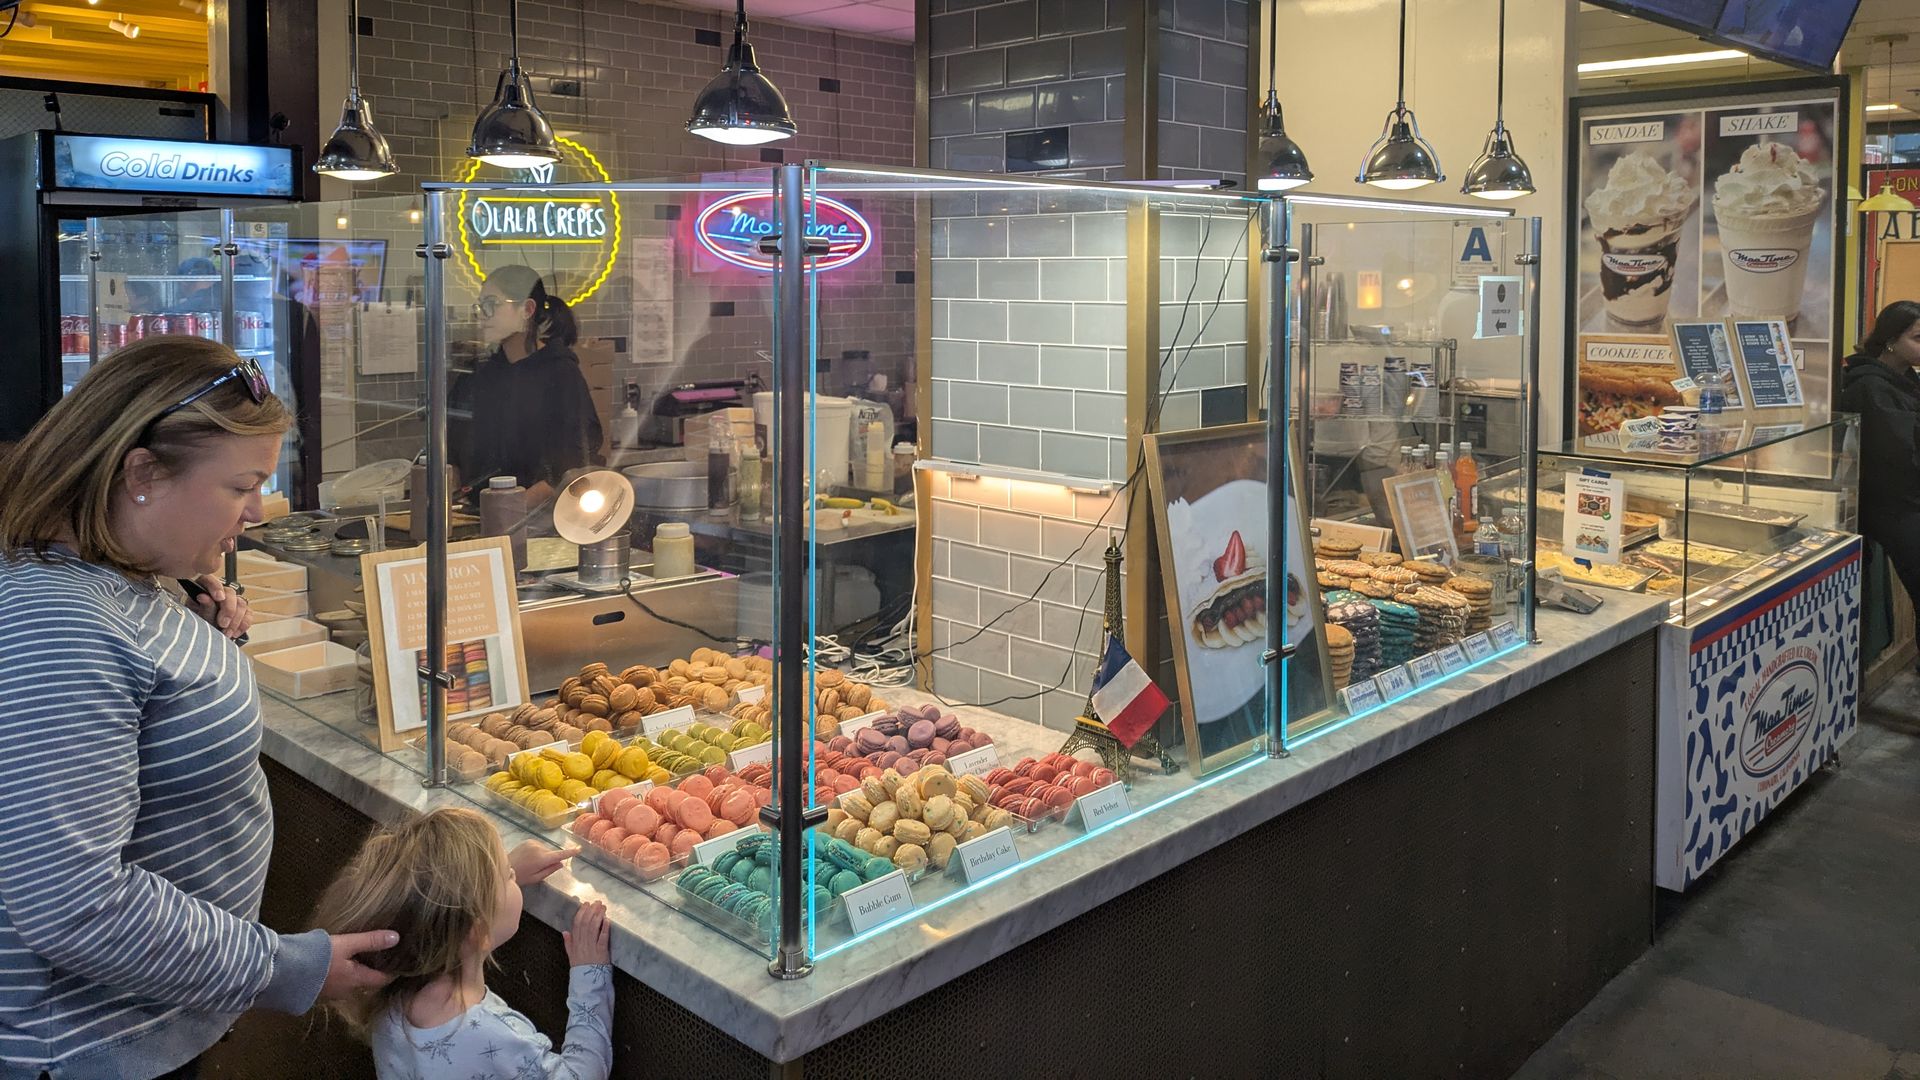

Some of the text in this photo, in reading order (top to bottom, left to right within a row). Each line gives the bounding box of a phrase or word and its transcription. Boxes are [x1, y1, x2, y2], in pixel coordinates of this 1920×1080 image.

[1593, 125, 1660, 140] SUNDAE
[1728, 116, 1790, 132] SHAKE
[100, 151, 254, 183] Cold Drinks
[472, 200, 606, 237] OLALA CREPES
[1461, 227, 1492, 262] A
[1590, 347, 1640, 360] COOKIE
[1643, 349, 1666, 361] ICE
[1745, 681, 1760, 712] LOCAL
[1762, 648, 1796, 683] HANDCRAFTED
[1750, 684, 1815, 743] Moo Time
[1092, 801, 1119, 817] Red Velvet
[969, 843, 1011, 868] Birthday Cake
[858, 892, 902, 916] Bubble Gum
